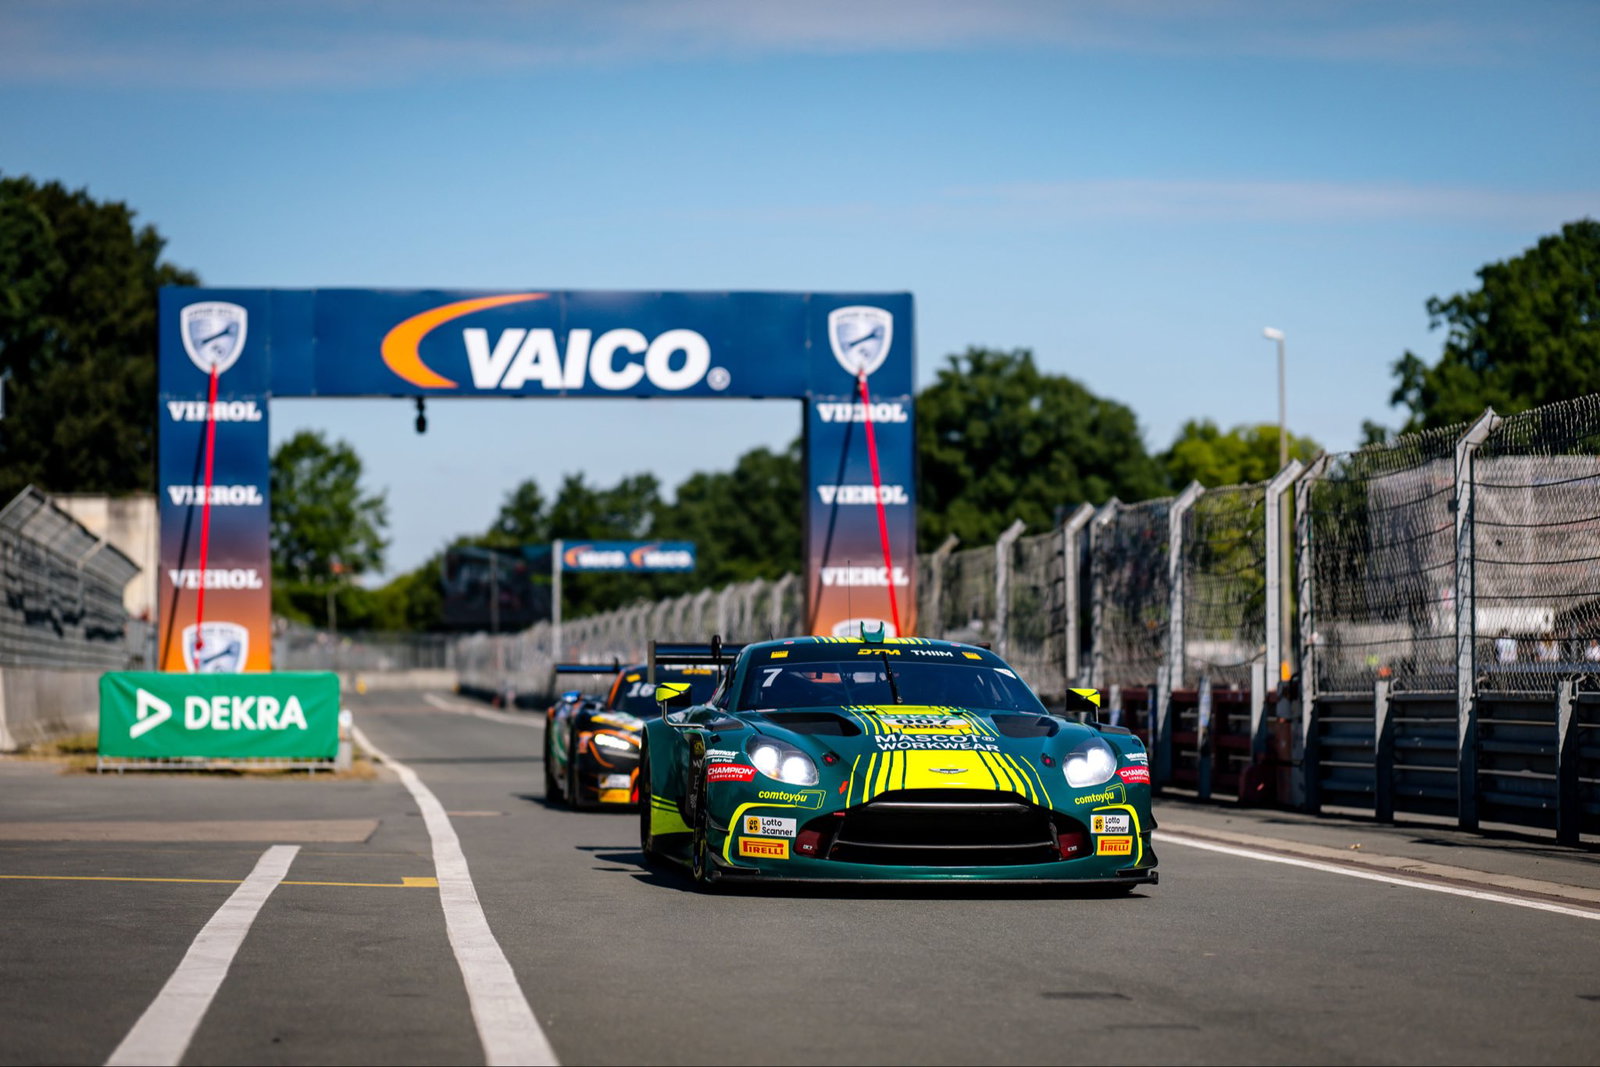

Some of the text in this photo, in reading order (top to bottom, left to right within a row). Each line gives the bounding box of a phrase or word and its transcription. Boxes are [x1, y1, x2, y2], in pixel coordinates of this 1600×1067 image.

[762, 668, 783, 687] 7
[184, 695, 308, 730] DEKRA
[877, 742, 1001, 752] WORKWEAR
[708, 766, 754, 775] CHAMPION
[758, 790, 807, 802] comtoyou
[1074, 791, 1115, 805] comtoyou
[762, 818, 782, 827] Lotto
[1105, 816, 1120, 824] Lotto
[762, 826, 793, 836] Scanner
[743, 840, 784, 855] PIRELLI
[1100, 840, 1130, 851] PIRELLI
